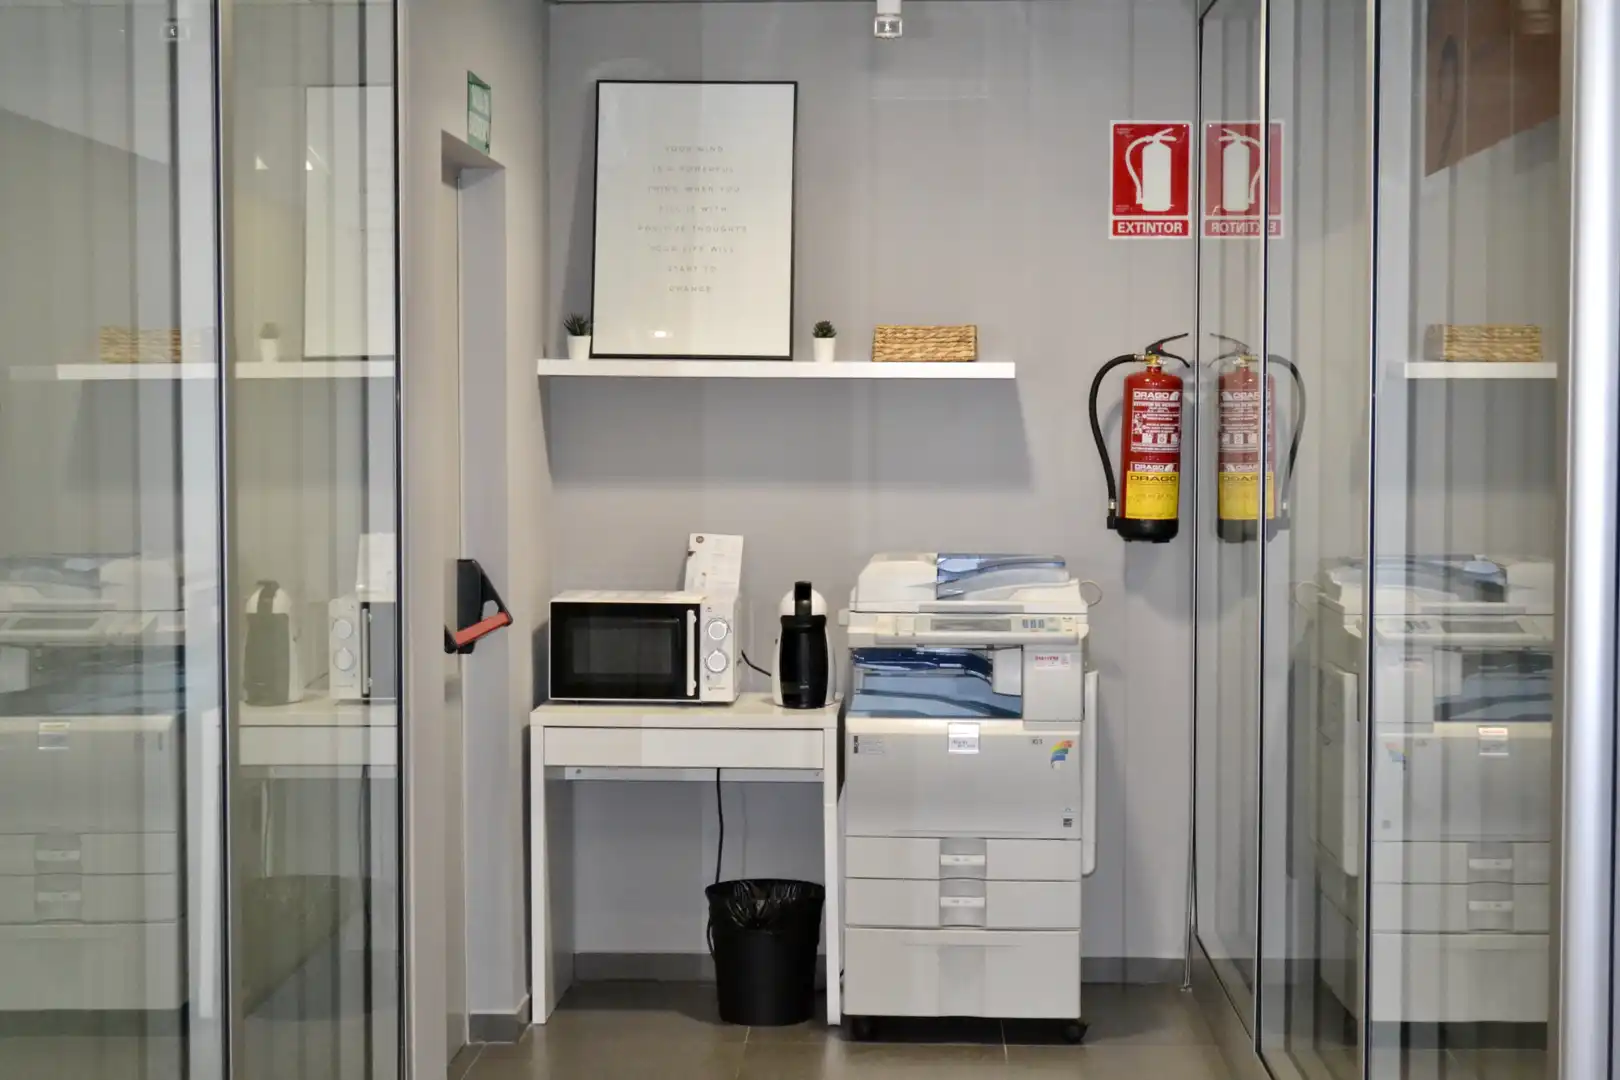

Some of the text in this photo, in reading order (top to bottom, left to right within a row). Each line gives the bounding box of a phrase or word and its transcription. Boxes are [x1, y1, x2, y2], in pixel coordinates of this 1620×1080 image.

[1117, 222, 1183, 233] EXTINTOR
[1133, 391, 1169, 400] DRAGO
[1134, 463, 1164, 471] DRAGO
